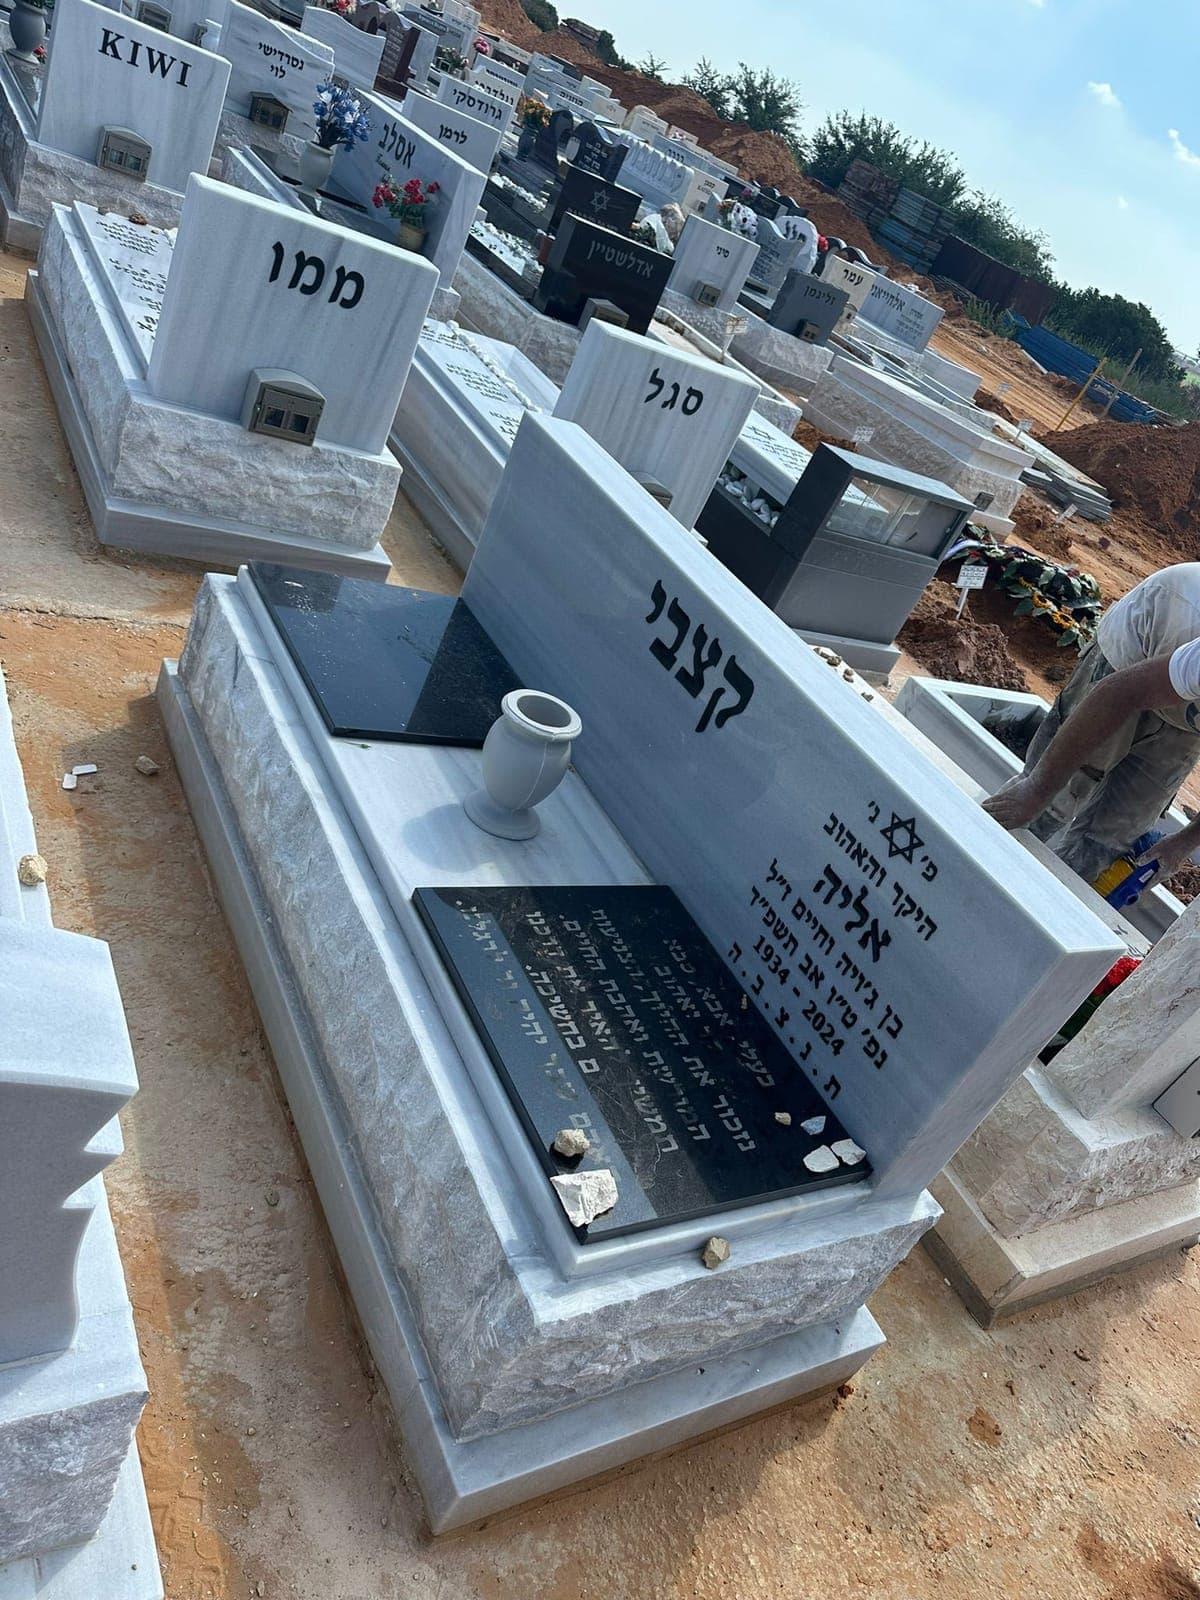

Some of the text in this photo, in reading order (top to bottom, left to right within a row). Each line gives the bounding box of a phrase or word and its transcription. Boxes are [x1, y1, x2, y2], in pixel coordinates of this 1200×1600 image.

[98, 28, 194, 88] KIWI
[259, 43, 304, 70] נסרדישי
[271, 65, 285, 78] לוי
[453, 89, 502, 120] גרודסקי
[437, 125, 467, 145] לרמן
[269, 241, 364, 309] ממן
[587, 241, 653, 277] אדלשטיין
[844, 269, 865, 286] עמר
[870, 284, 906, 315] אלחייאני
[644, 368, 703, 415] סגל
[645, 580, 754, 733] קצבי
[823, 813, 937, 941] היקר והאהוב
[791, 898, 835, 955] וחיים
[813, 864, 893, 962] אליה
[556, 965, 586, 992] את
[798, 953, 825, 989] אב
[525, 964, 587, 1049] בחשיכה.
[598, 979, 649, 1041] ואהבת
[753, 935, 790, 985] 1934
[802, 1000, 845, 1056] 2024
[877, 1005, 903, 1039] בן
[681, 1056, 717, 1086] את
[713, 1094, 757, 1151] נזכור
